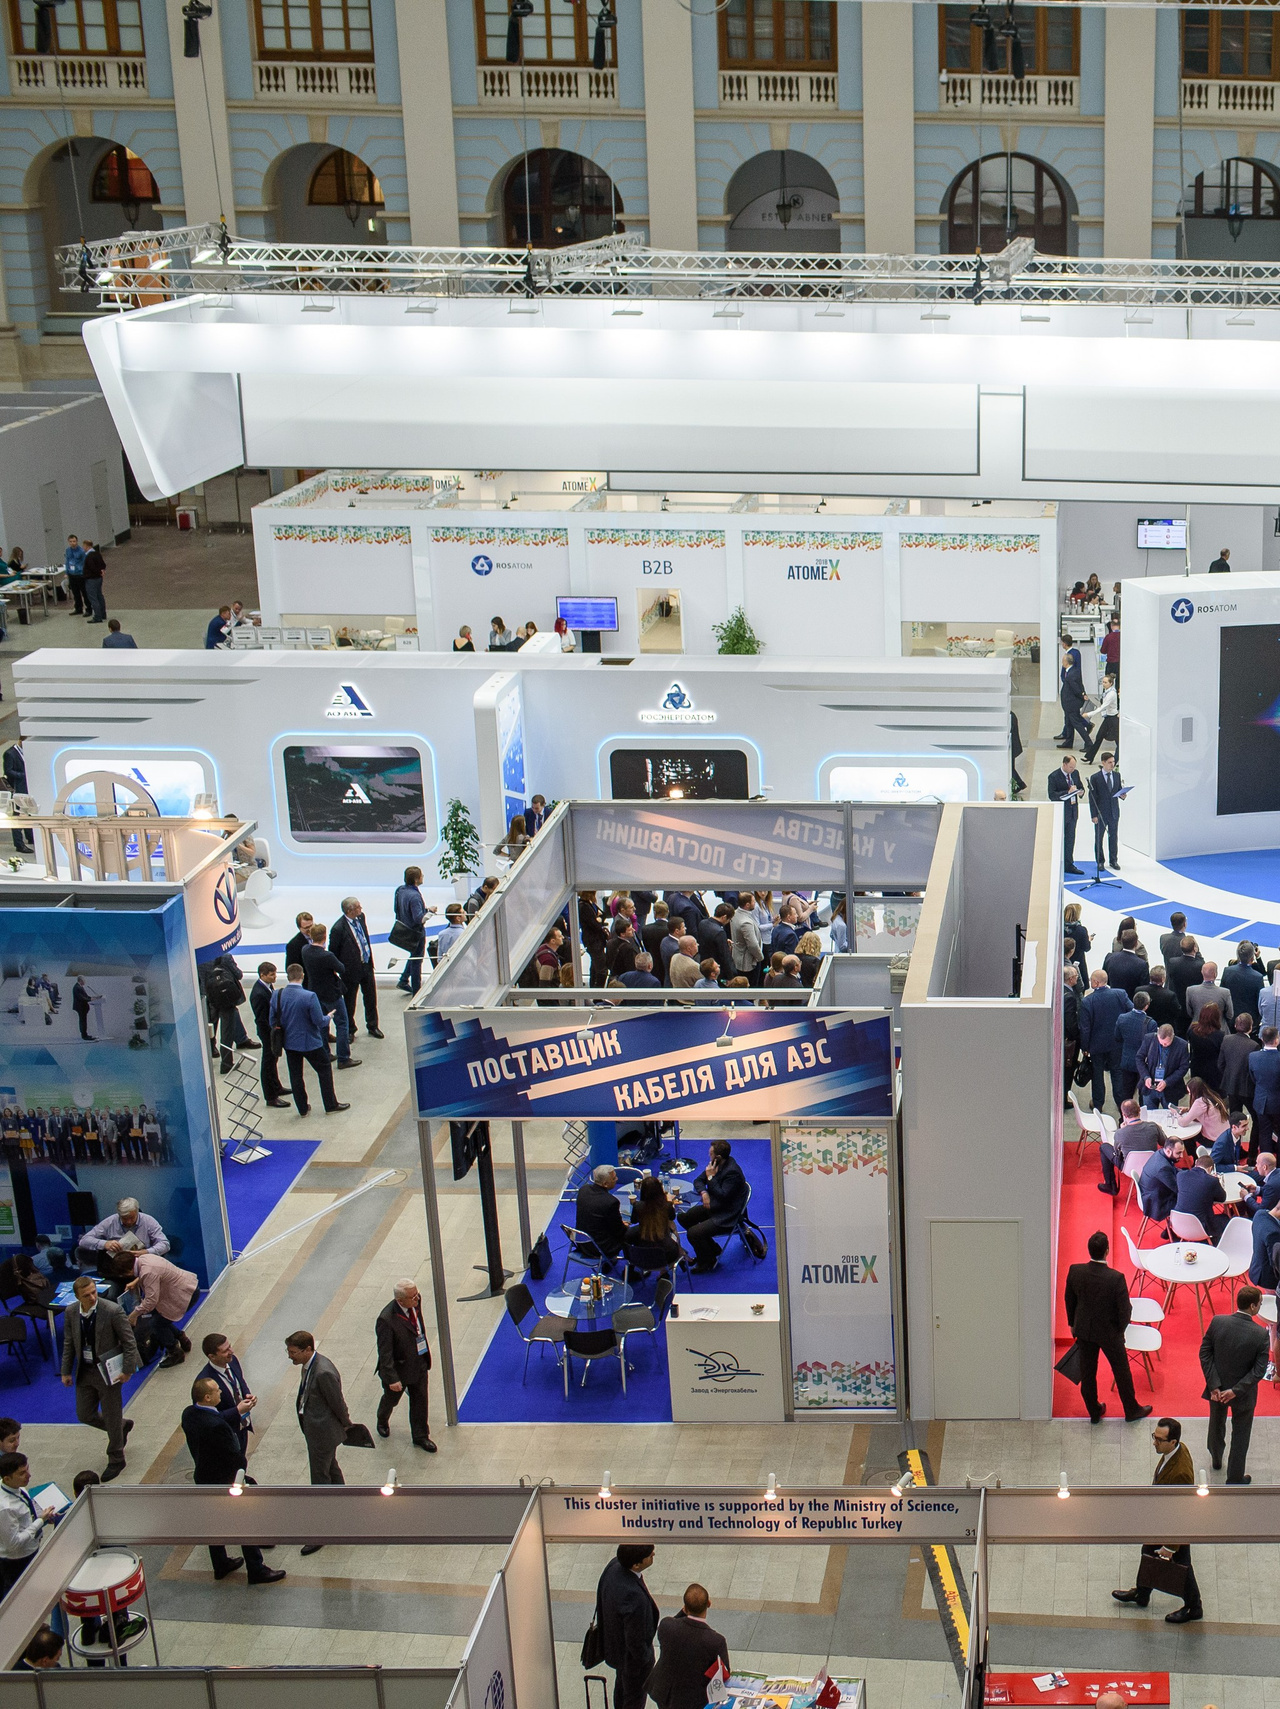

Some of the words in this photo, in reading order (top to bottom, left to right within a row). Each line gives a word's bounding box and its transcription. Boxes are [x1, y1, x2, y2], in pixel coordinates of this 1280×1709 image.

[562, 477, 597, 491] ATOMEX
[642, 560, 673, 575] B2B
[787, 559, 841, 581] ATOMEX
[1197, 604, 1237, 613] ROSATOM
[467, 1029, 622, 1088] ПОСТАВЩИК
[613, 1065, 715, 1112] КАБЕЛЯ
[724, 1050, 777, 1091] ДЛЯ
[787, 1038, 832, 1073] АЭС
[841, 1255, 859, 1264] 2018
[801, 1255, 879, 1284] ATOMEX
[564, 1497, 590, 1510] This
[595, 1497, 637, 1510] cluster
[642, 1498, 700, 1511] initiative
[719, 1499, 785, 1514] supported
[789, 1499, 804, 1514] by
[808, 1499, 829, 1511] the
[834, 1499, 886, 1514] Ministry
[890, 1499, 903, 1511] of
[907, 1499, 959, 1514] Science,
[622, 1515, 674, 1531] Industry
[679, 1516, 703, 1529] and
[708, 1516, 780, 1532] Technology
[785, 1516, 797, 1529] of
[861, 1517, 902, 1532] Turkey
